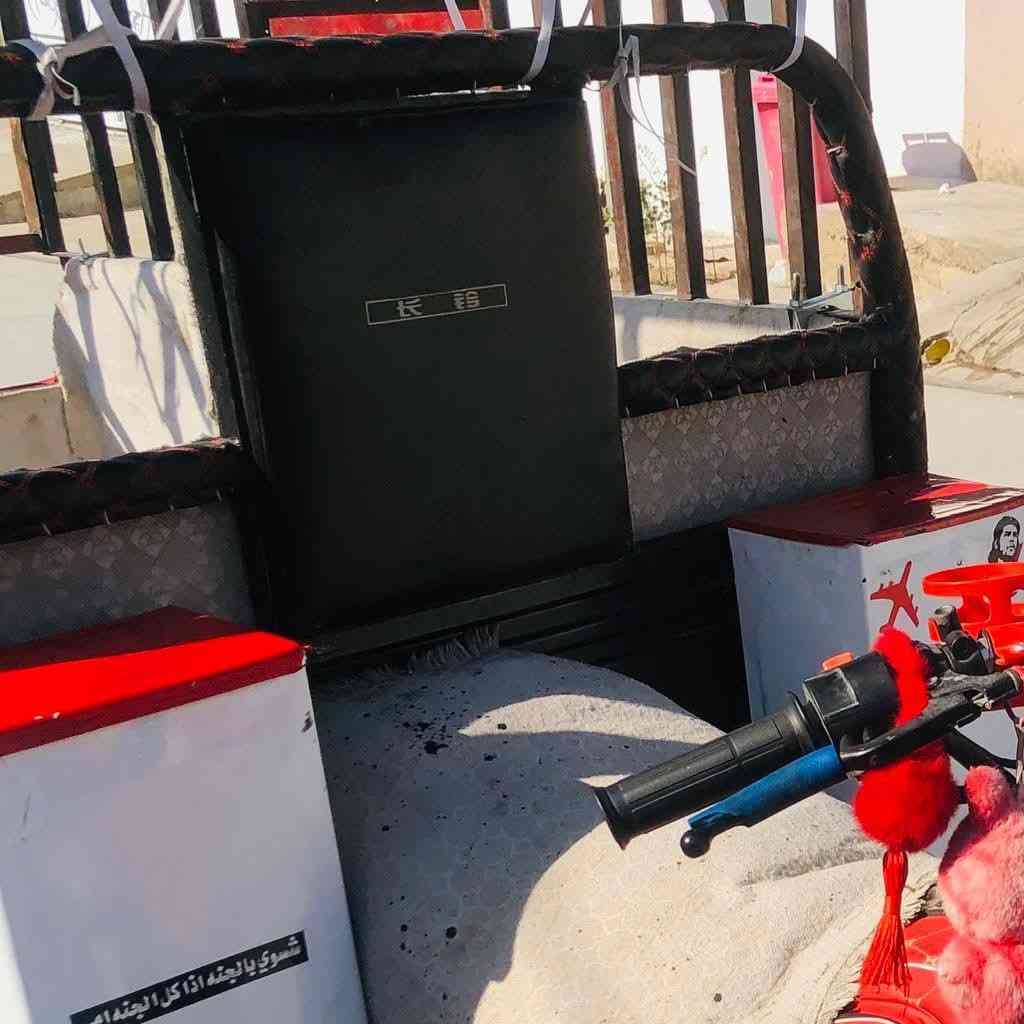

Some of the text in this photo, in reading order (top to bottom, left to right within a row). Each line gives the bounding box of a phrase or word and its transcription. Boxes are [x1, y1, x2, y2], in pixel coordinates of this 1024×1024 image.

[159, 981, 181, 1008] كل
[182, 974, 205, 995] اذا
[112, 991, 159, 1021] الجنه
